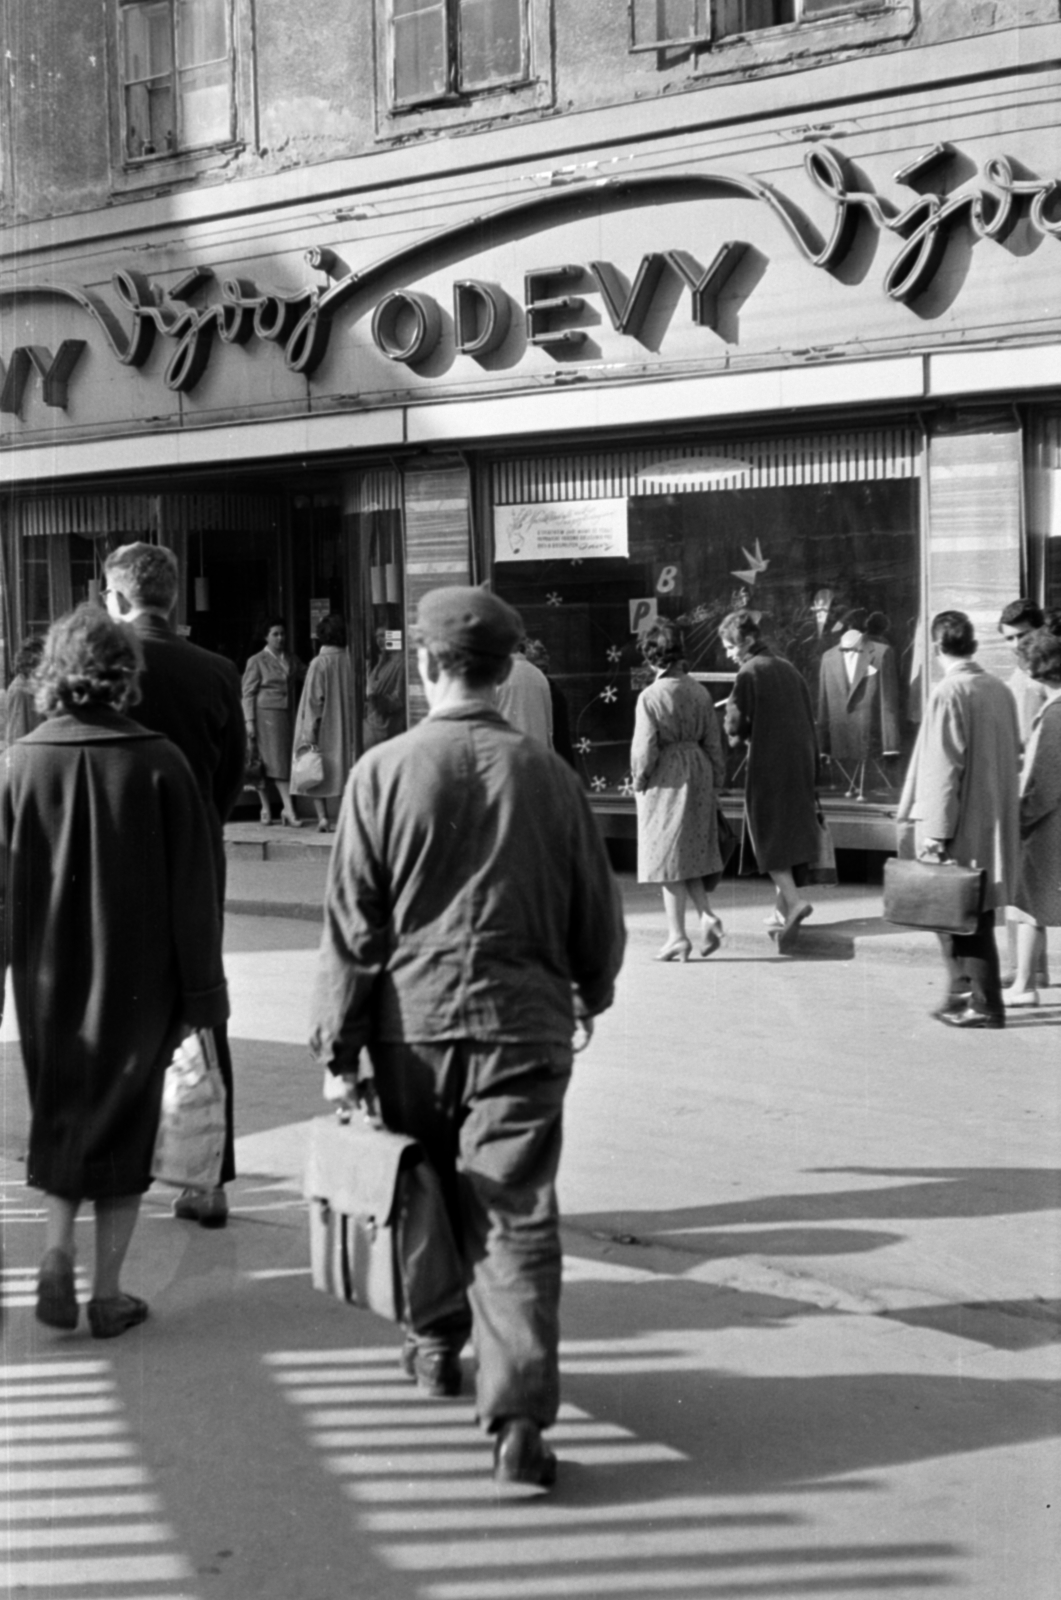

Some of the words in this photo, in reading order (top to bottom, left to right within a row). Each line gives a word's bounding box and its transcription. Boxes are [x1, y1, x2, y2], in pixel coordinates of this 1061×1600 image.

[371, 240, 755, 368] ODEVY
[656, 565, 678, 594] B
[632, 600, 651, 631] P
